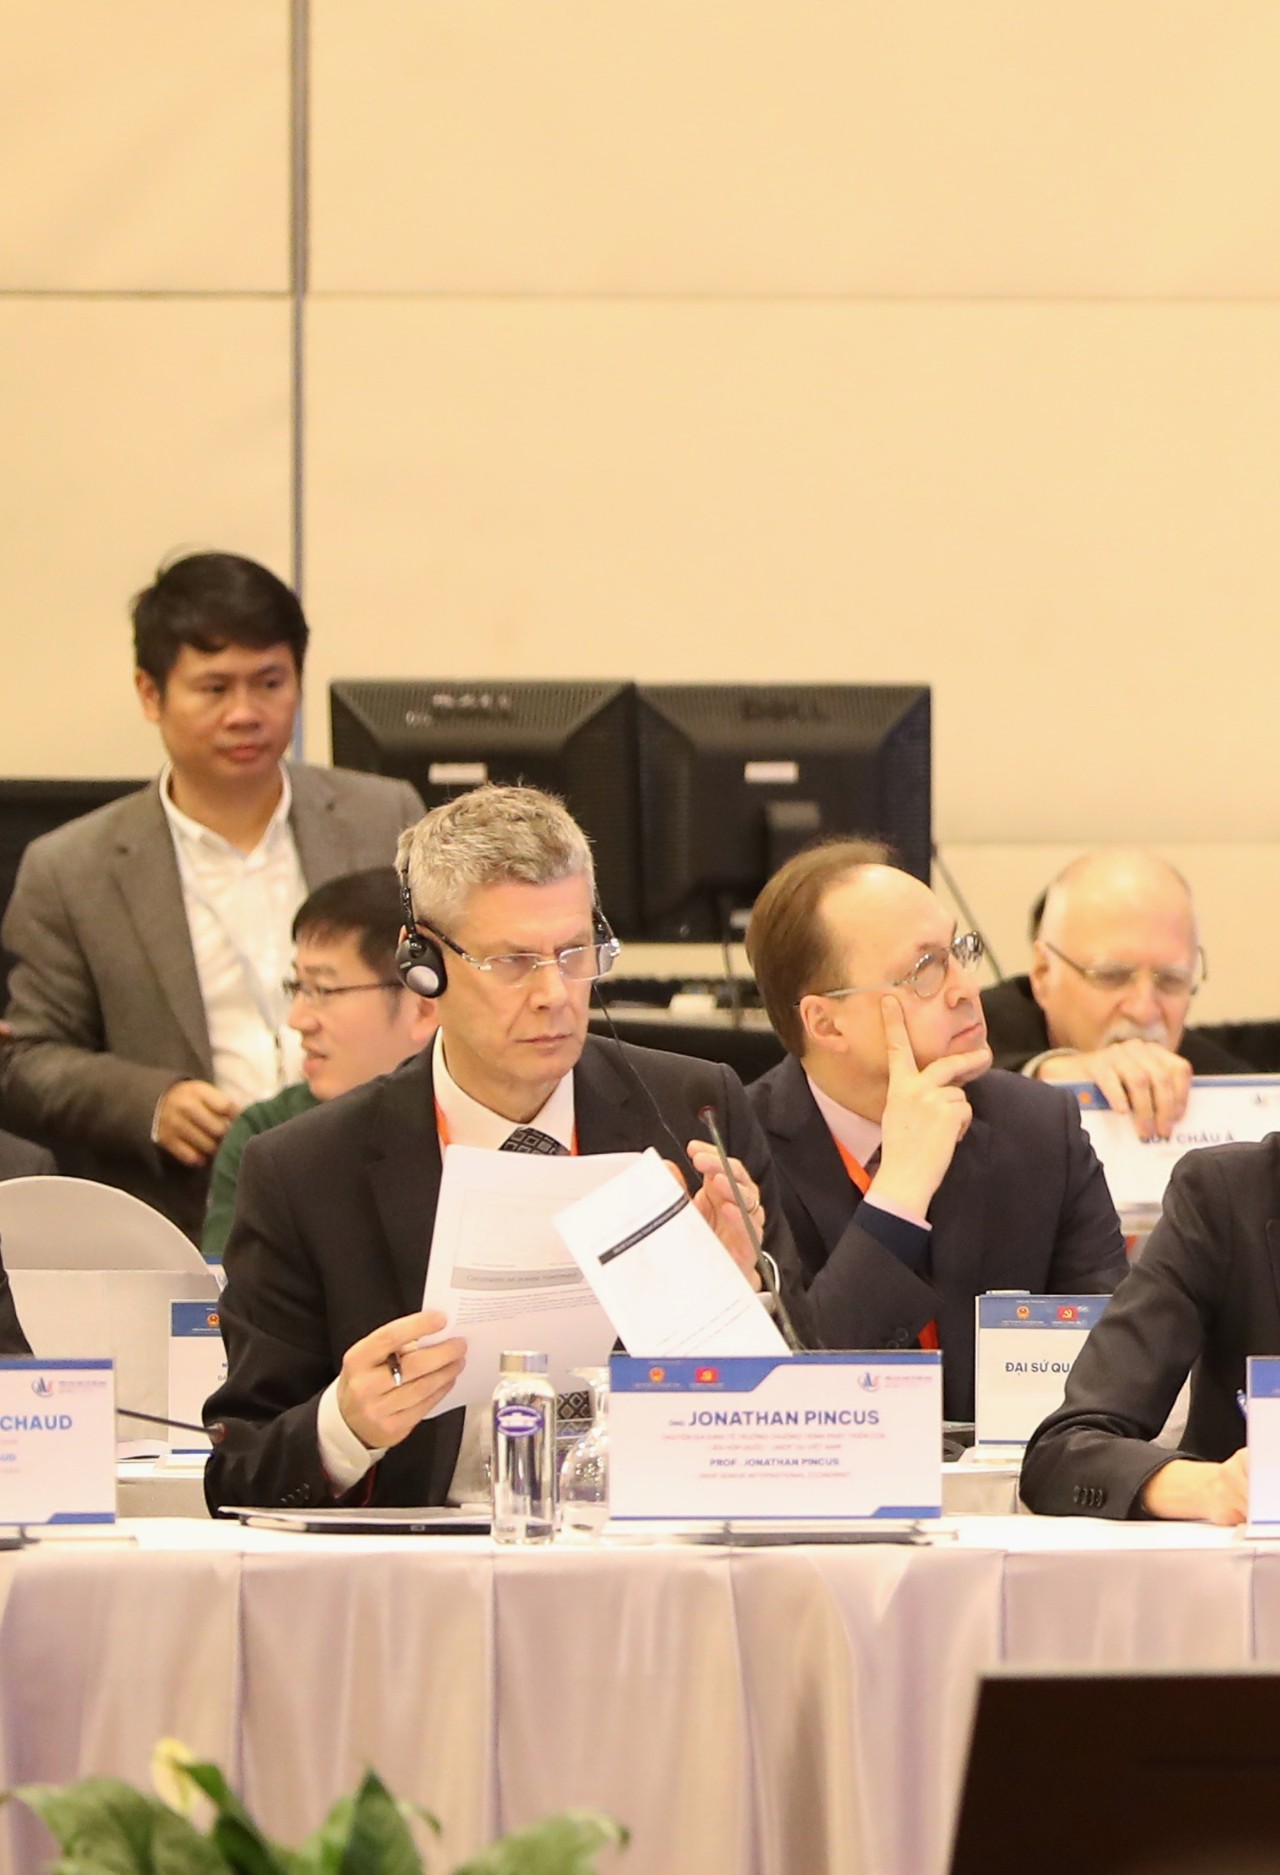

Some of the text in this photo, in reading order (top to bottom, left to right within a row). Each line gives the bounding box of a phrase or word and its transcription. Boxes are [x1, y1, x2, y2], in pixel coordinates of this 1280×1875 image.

[1005, 1361, 1028, 1375] ĐẠI
[1031, 1359, 1049, 1373] SỨ
[0, 1414, 73, 1431] CHAUD
[688, 1411, 799, 1427] JONATHAN
[804, 1410, 880, 1426] PINCUS
[744, 1458, 799, 1467] JONATHAN
[801, 1457, 840, 1466] PINCUS
